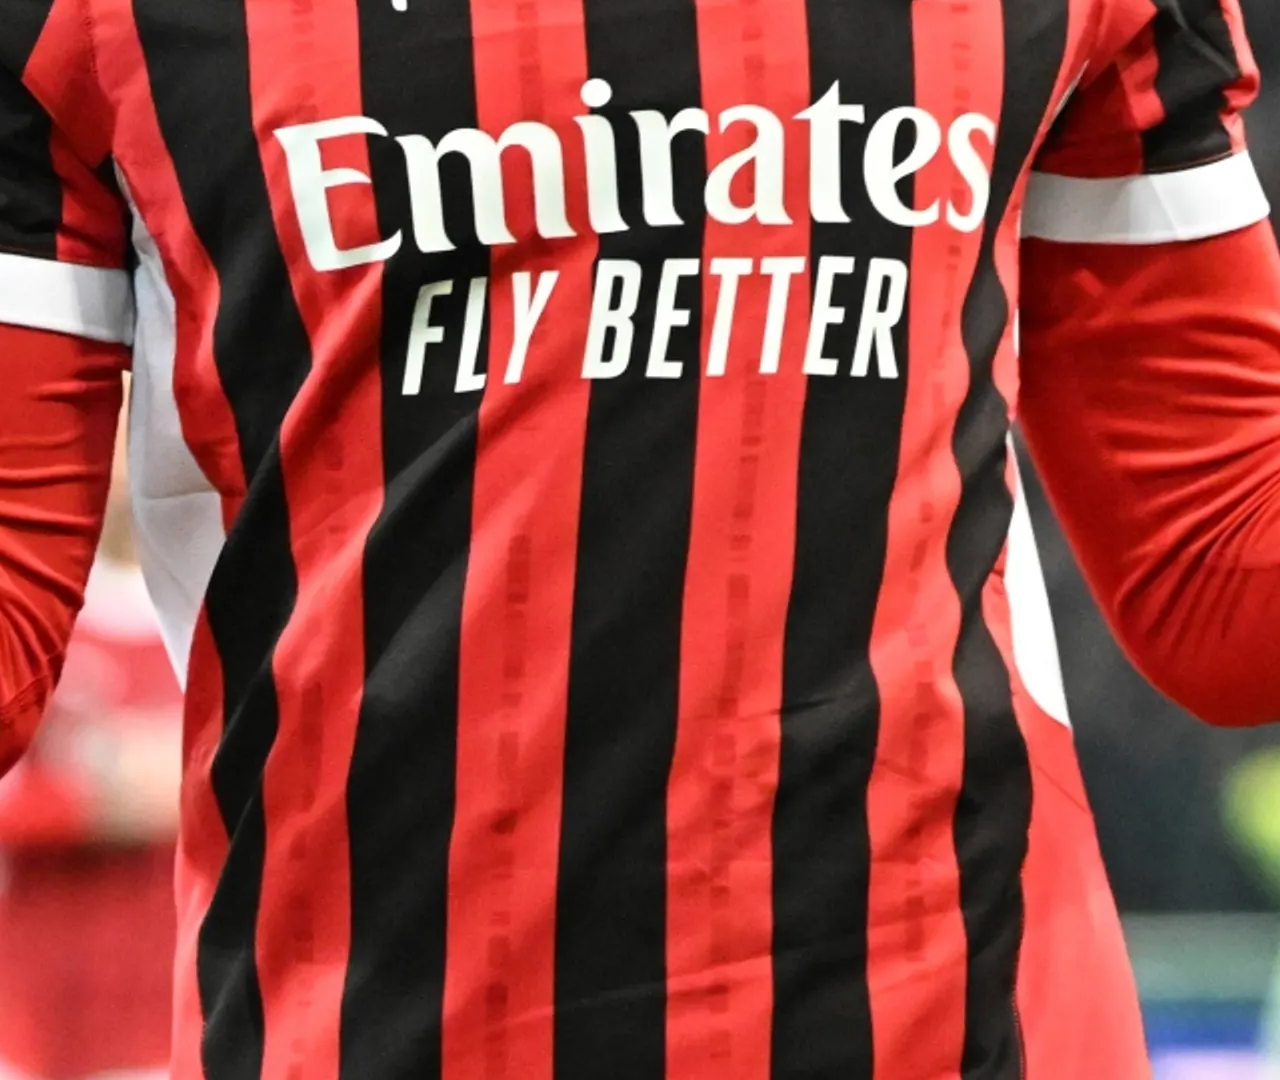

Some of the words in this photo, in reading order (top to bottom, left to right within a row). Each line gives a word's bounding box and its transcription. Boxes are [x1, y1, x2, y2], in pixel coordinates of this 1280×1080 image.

[273, 77, 997, 272] Emirates
[401, 269, 560, 396] FLY
[580, 255, 909, 380] BETTER
